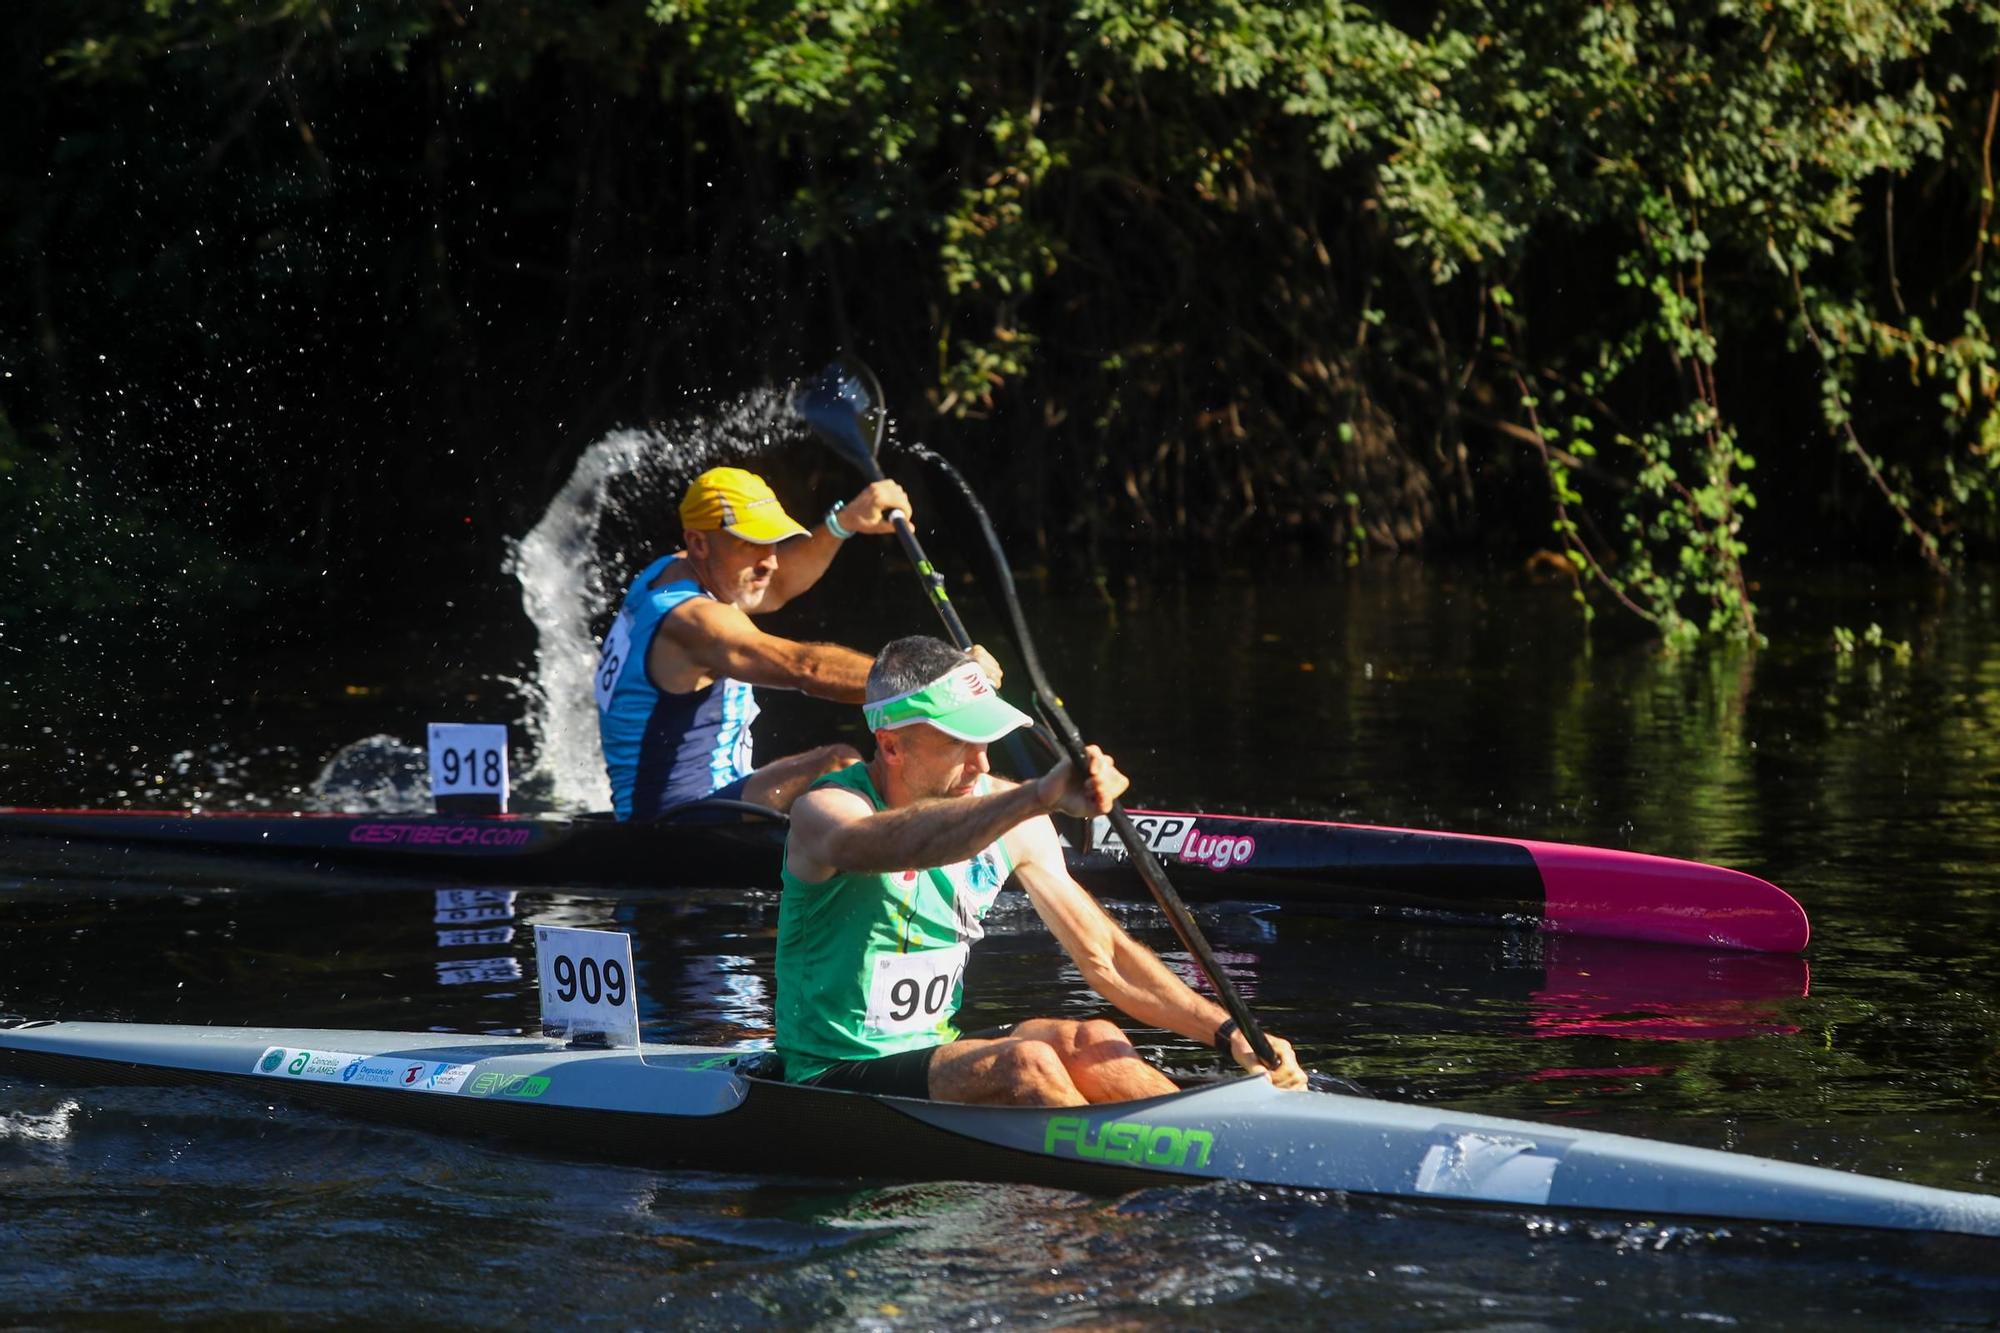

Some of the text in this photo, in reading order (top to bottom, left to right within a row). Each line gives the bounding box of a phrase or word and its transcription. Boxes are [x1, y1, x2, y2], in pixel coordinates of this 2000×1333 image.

[442, 748, 500, 786] 918
[1182, 830, 1252, 869] Lugo
[554, 954, 626, 1007] 909
[889, 973, 952, 1022] 90
[306, 1066, 337, 1075] de AMES
[311, 1056, 339, 1067] Concello
[360, 1065, 395, 1076] Deputación
[470, 1072, 529, 1096] EVO
